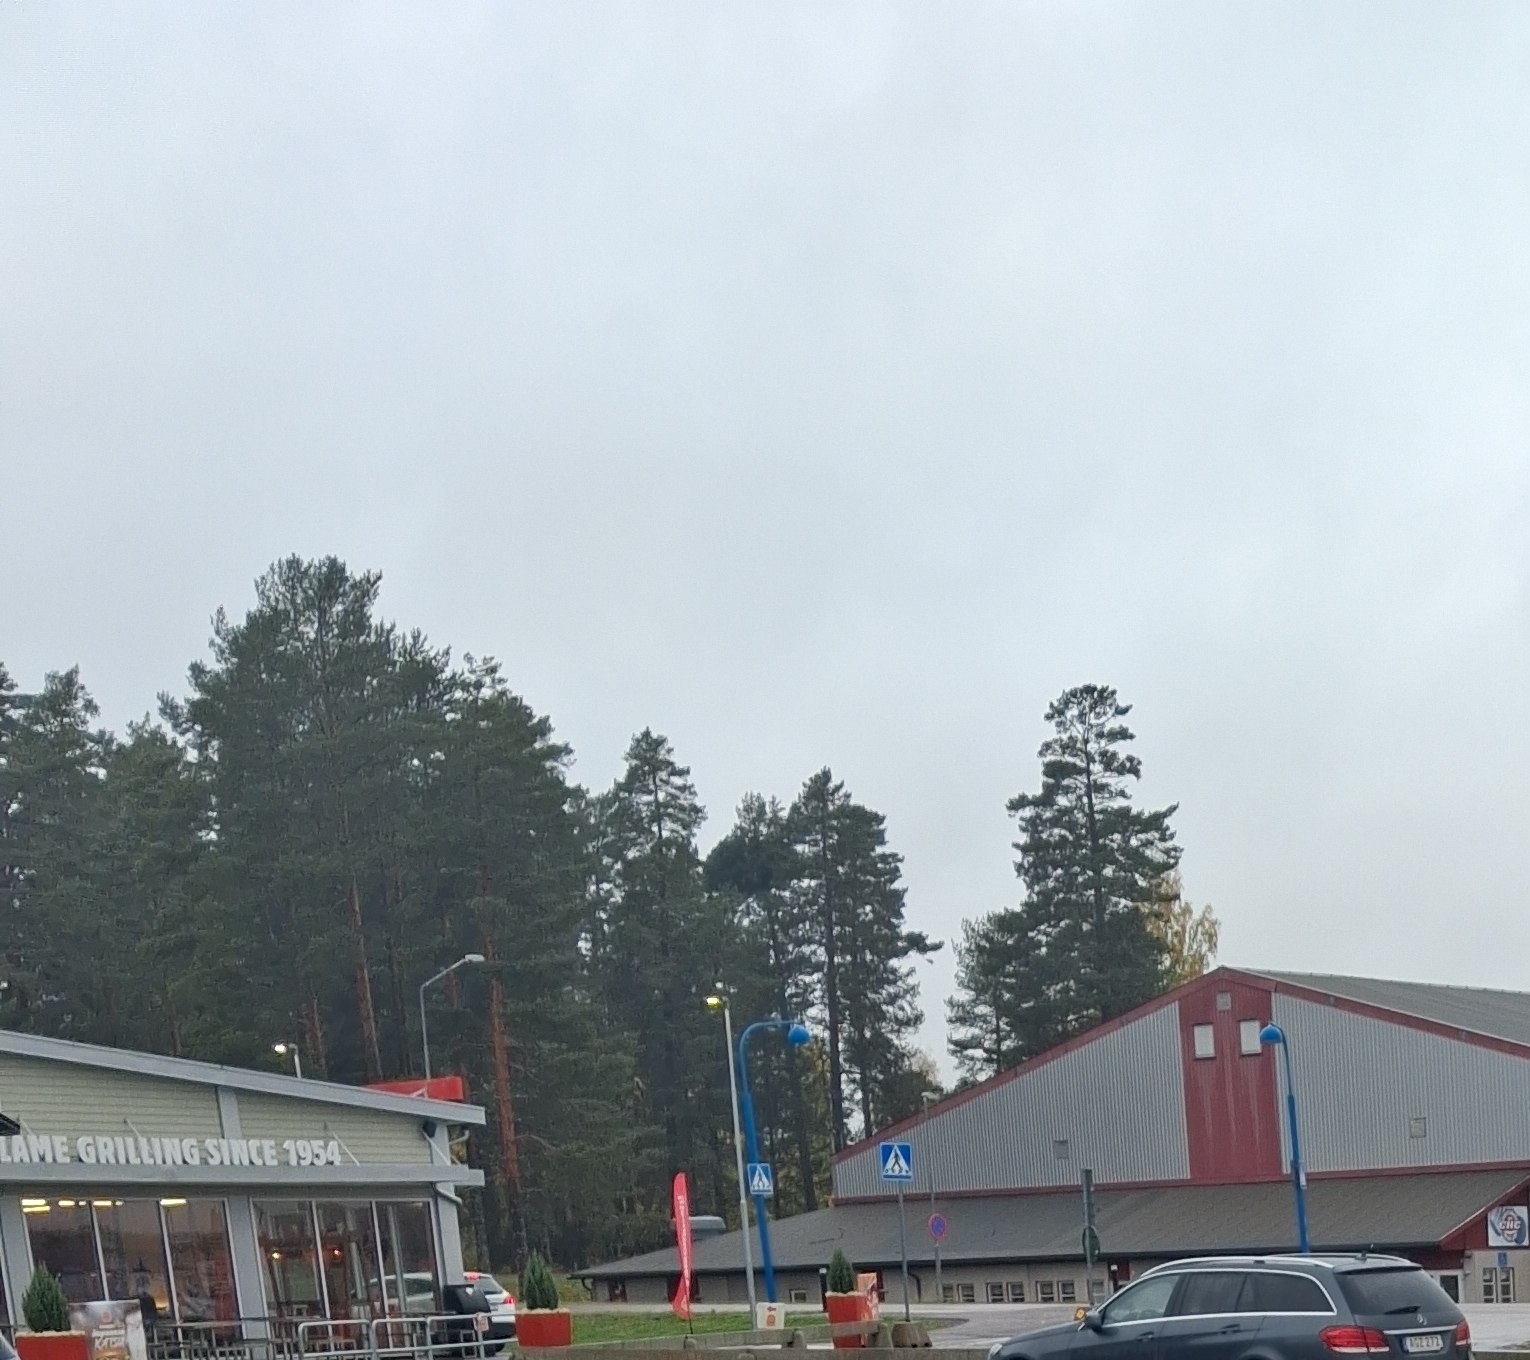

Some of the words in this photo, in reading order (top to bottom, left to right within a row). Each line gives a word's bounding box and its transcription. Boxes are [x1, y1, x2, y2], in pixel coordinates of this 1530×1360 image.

[77, 1135, 200, 1165] GRILLING
[205, 1138, 278, 1166] SINCE
[283, 1139, 341, 1167] 1954
